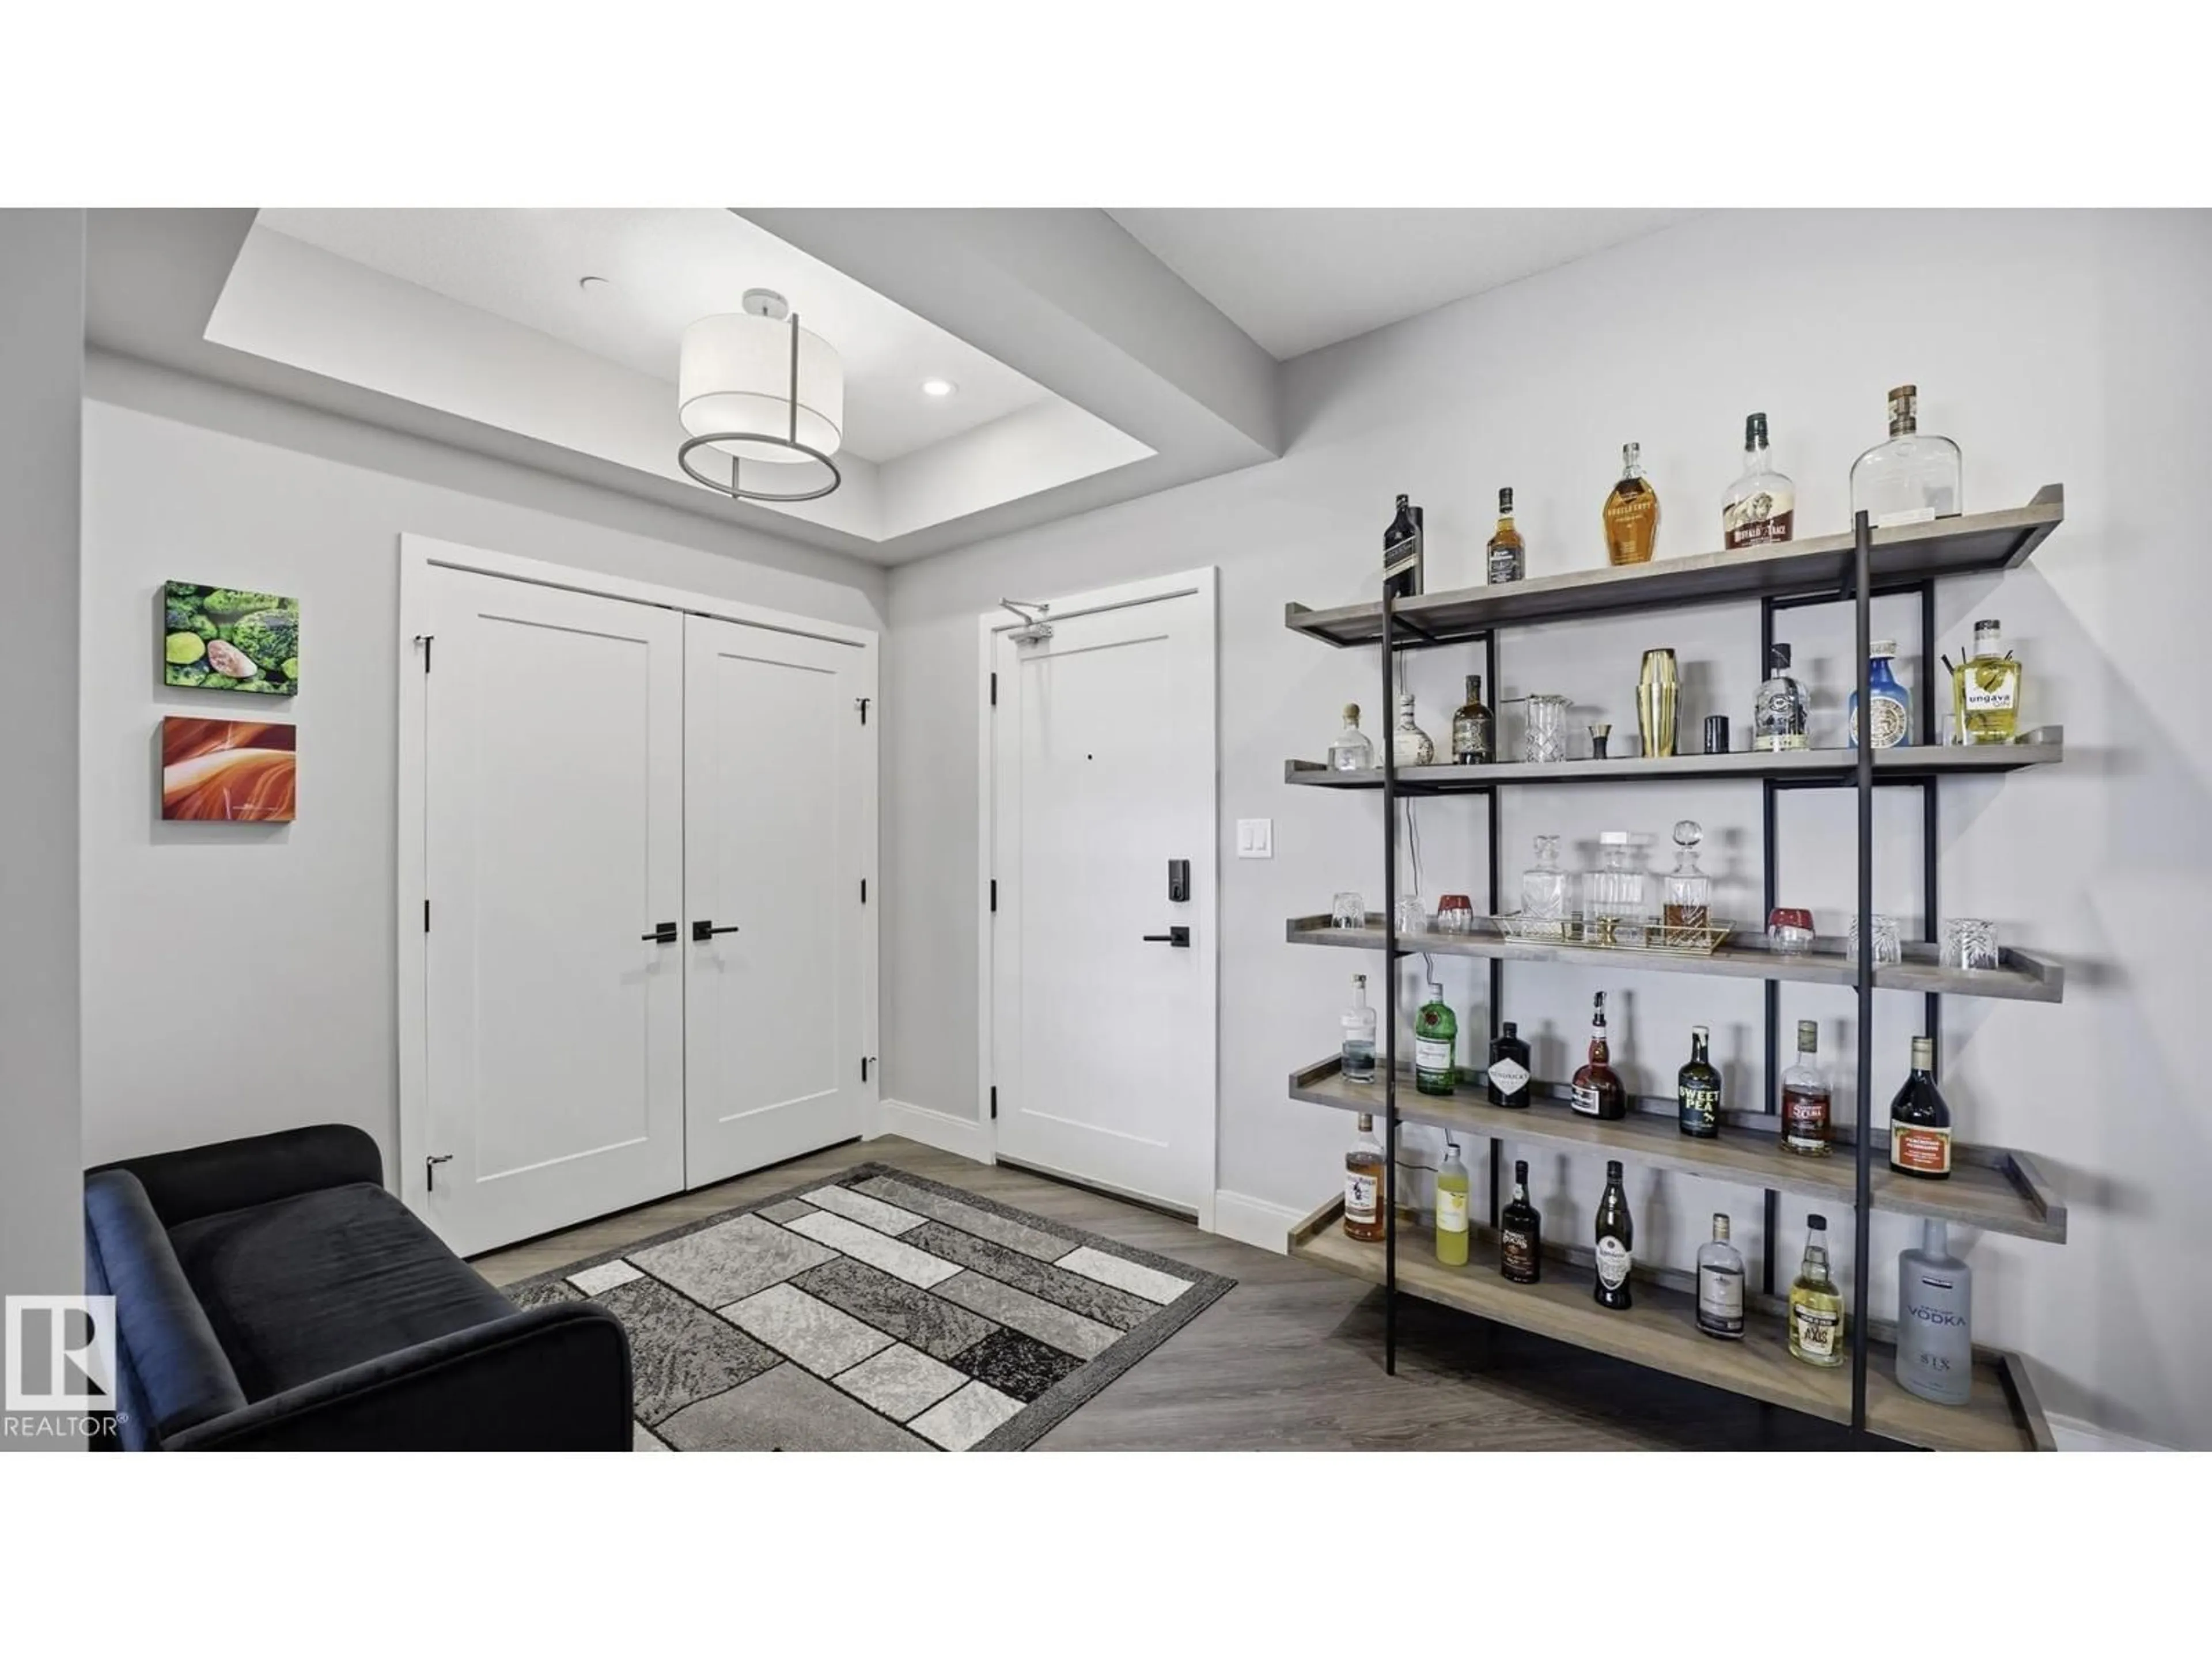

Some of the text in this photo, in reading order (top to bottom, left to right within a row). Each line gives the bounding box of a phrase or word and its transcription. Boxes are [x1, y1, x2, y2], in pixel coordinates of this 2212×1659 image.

[1969, 695, 2010, 703] ungava
[1680, 1085, 1719, 1101] SWEET
[1686, 1098, 1713, 1112] PEA
[1908, 1305, 1967, 1327] VODKA
